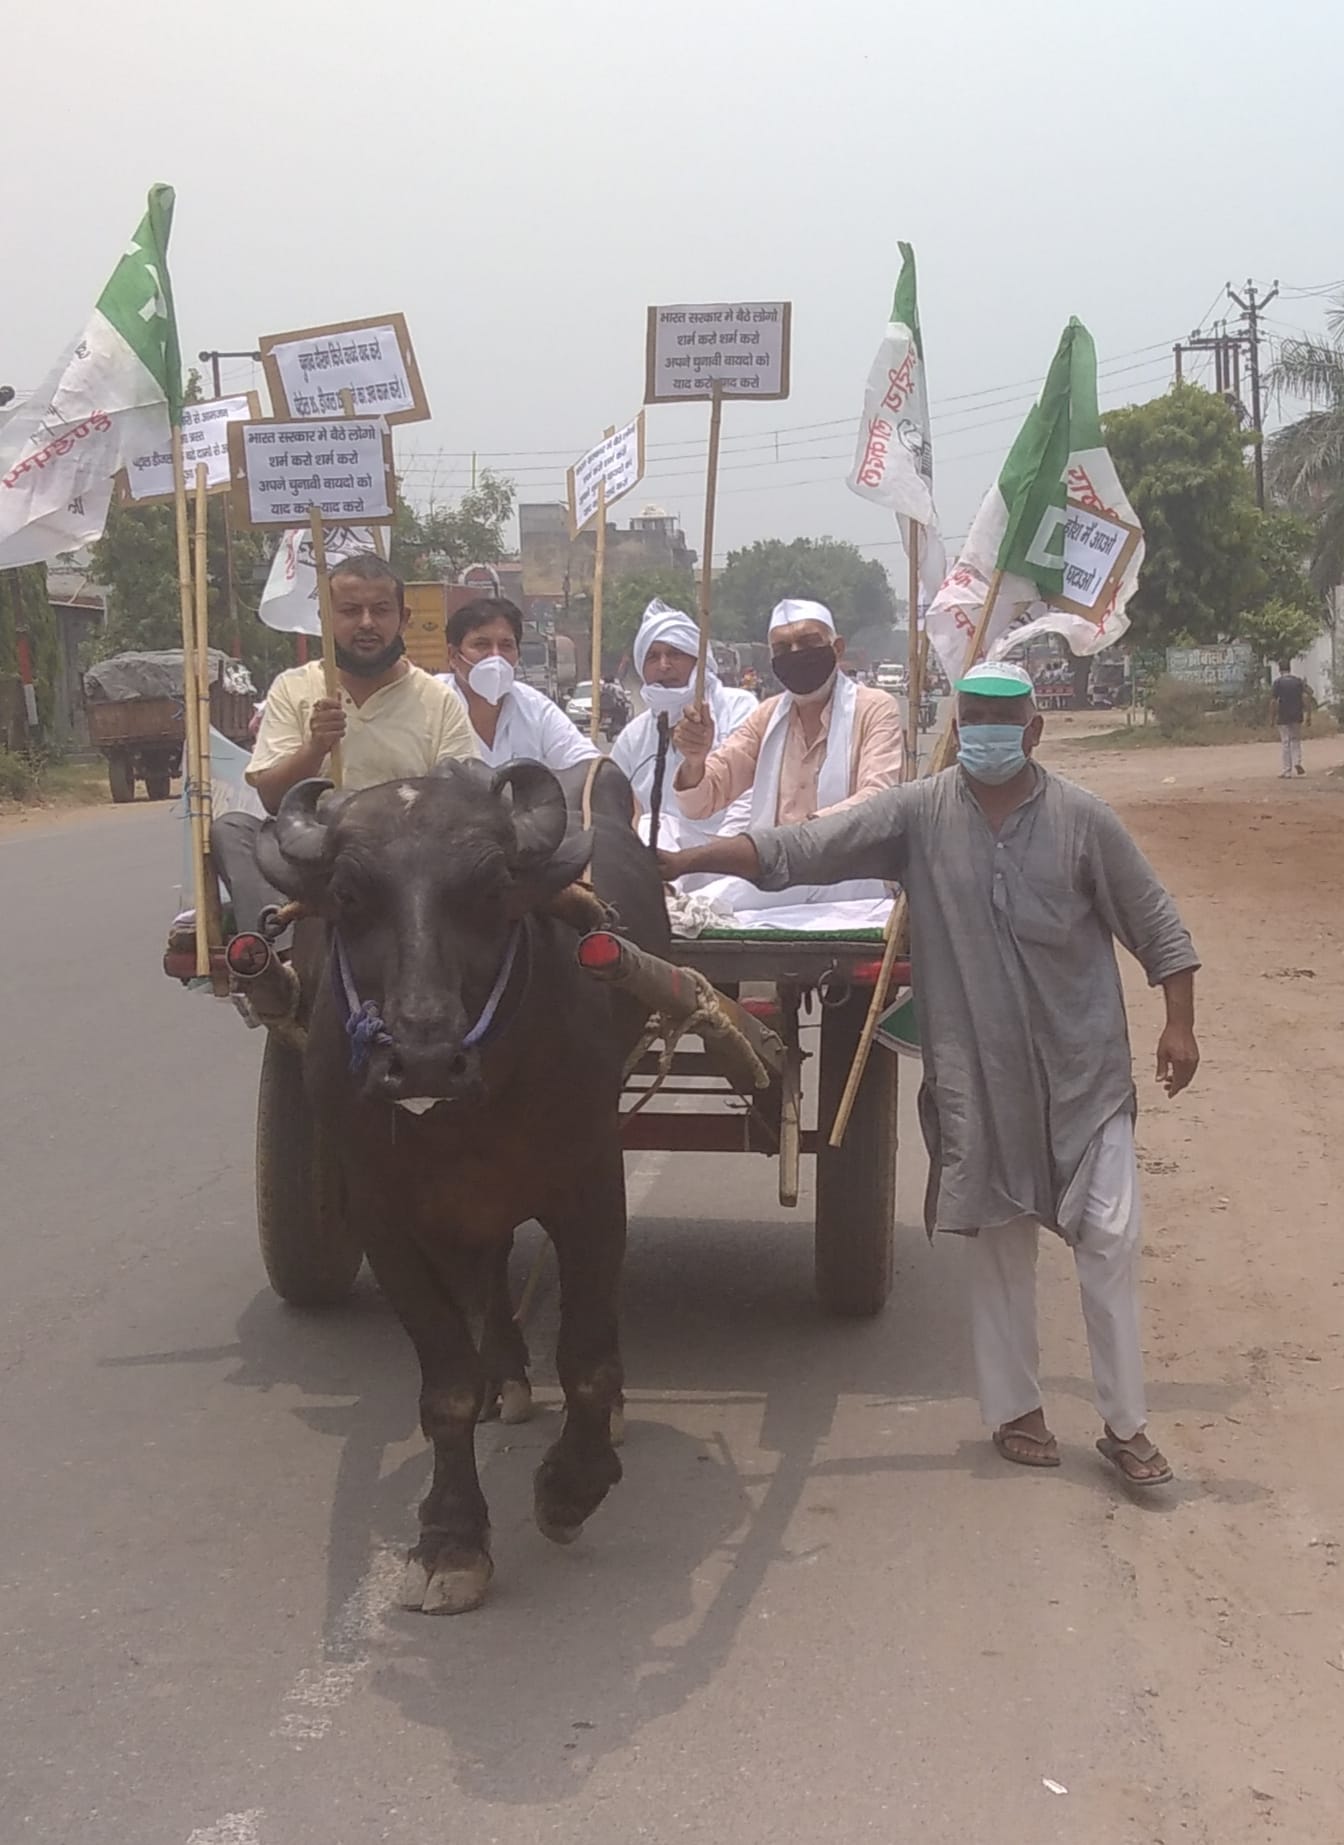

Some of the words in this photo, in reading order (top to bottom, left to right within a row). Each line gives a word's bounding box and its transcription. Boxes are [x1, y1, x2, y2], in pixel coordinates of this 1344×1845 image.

[660, 311, 685, 323] भारत
[688, 311, 722, 323] सरकार
[736, 308, 751, 322] बैठे
[753, 307, 778, 322] लोगो
[677, 331, 696, 346] शर्म
[698, 331, 717, 345] करो
[719, 329, 738, 344] शर्म
[740, 330, 760, 344] करो
[664, 355, 691, 368] अपने
[693, 352, 722, 372] चुनावी
[756, 352, 770, 366] को
[673, 378, 691, 389] याद
[740, 374, 760, 388] करो
[248, 432, 275, 444] भारत
[278, 430, 315, 443] सरकार
[330, 426, 346, 440] बैठे
[348, 425, 376, 440] लोगो
[269, 451, 288, 467] शर्म
[291, 451, 313, 466] करो
[315, 449, 334, 465] शर्म
[337, 450, 358, 465] करो
[259, 476, 286, 492] अपने
[288, 474, 321, 496] चुनावी
[323, 474, 354, 489] वायदो
[357, 473, 372, 488] को
[271, 503, 291, 514] याद
[320, 501, 341, 513] याद
[342, 497, 364, 513] करो
